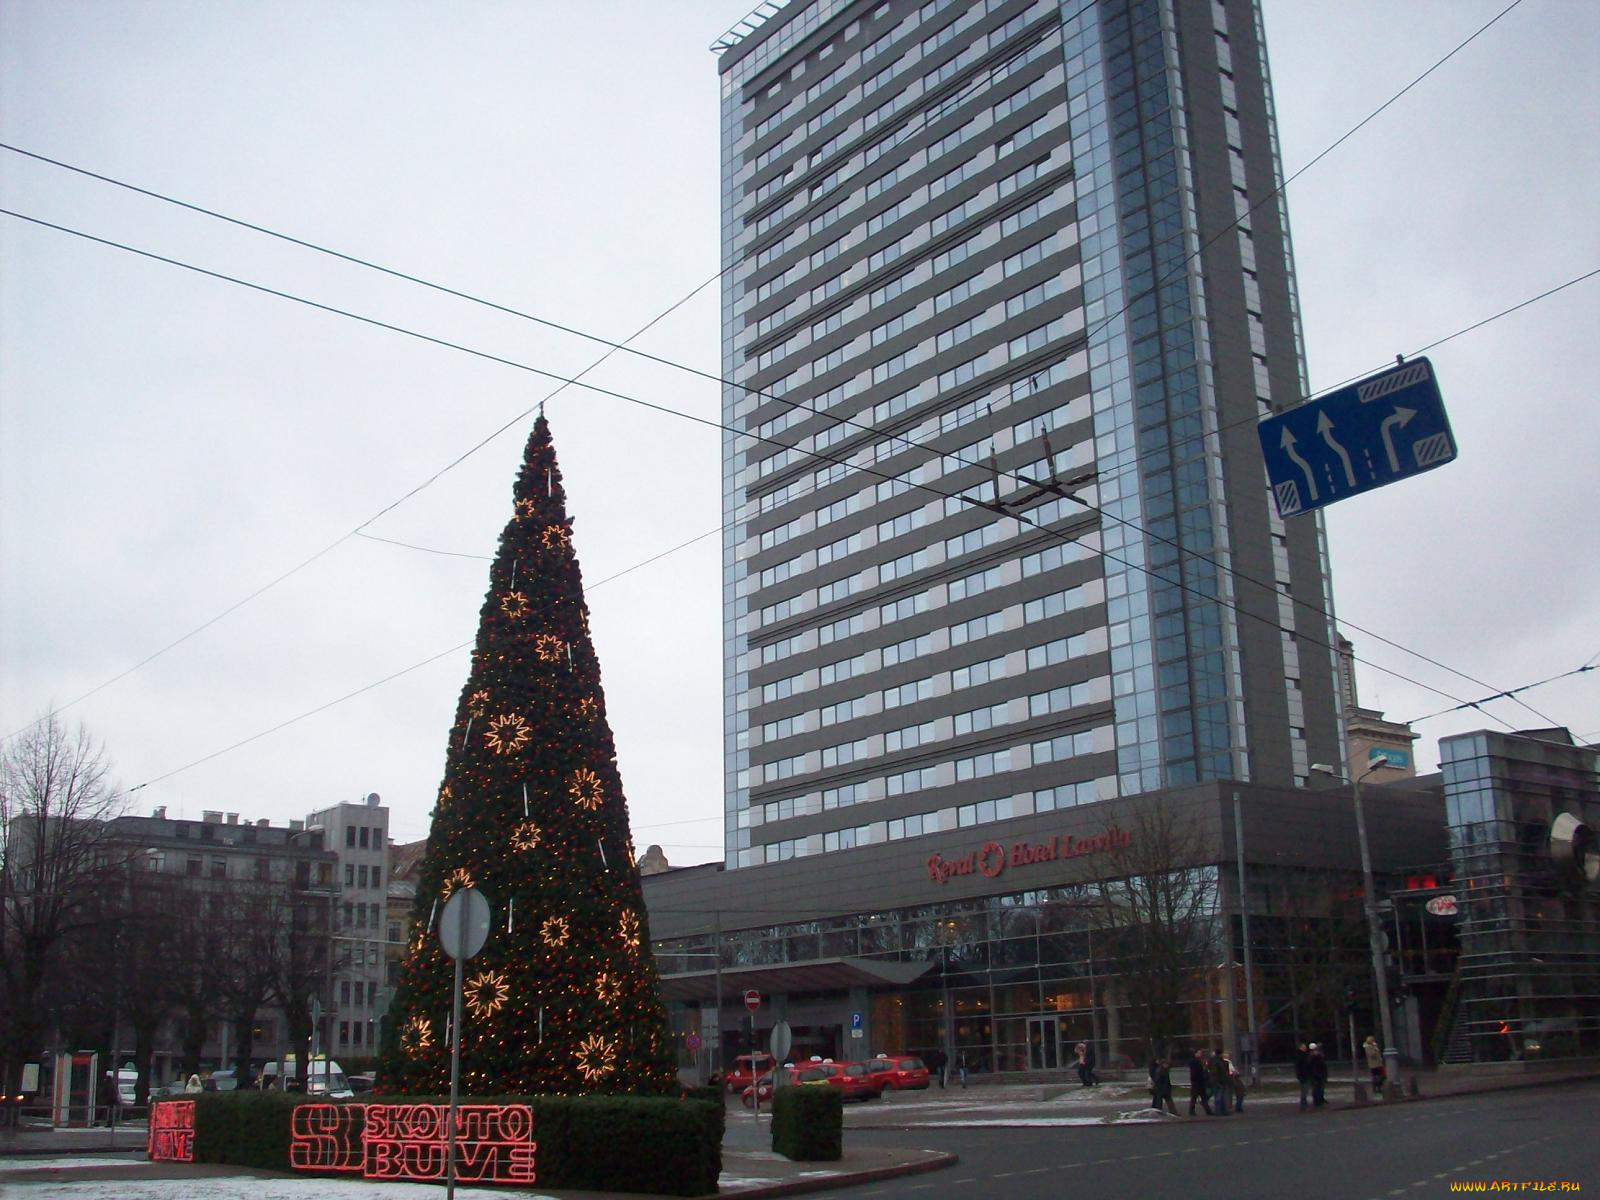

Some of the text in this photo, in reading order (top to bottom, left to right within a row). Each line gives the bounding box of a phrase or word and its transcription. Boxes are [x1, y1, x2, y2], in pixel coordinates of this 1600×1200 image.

[1009, 835, 1058, 868] Hotel
[853, 1014, 860, 1027] P
[365, 1103, 533, 1142] SKONTO
[363, 1140, 537, 1183] BUVE
